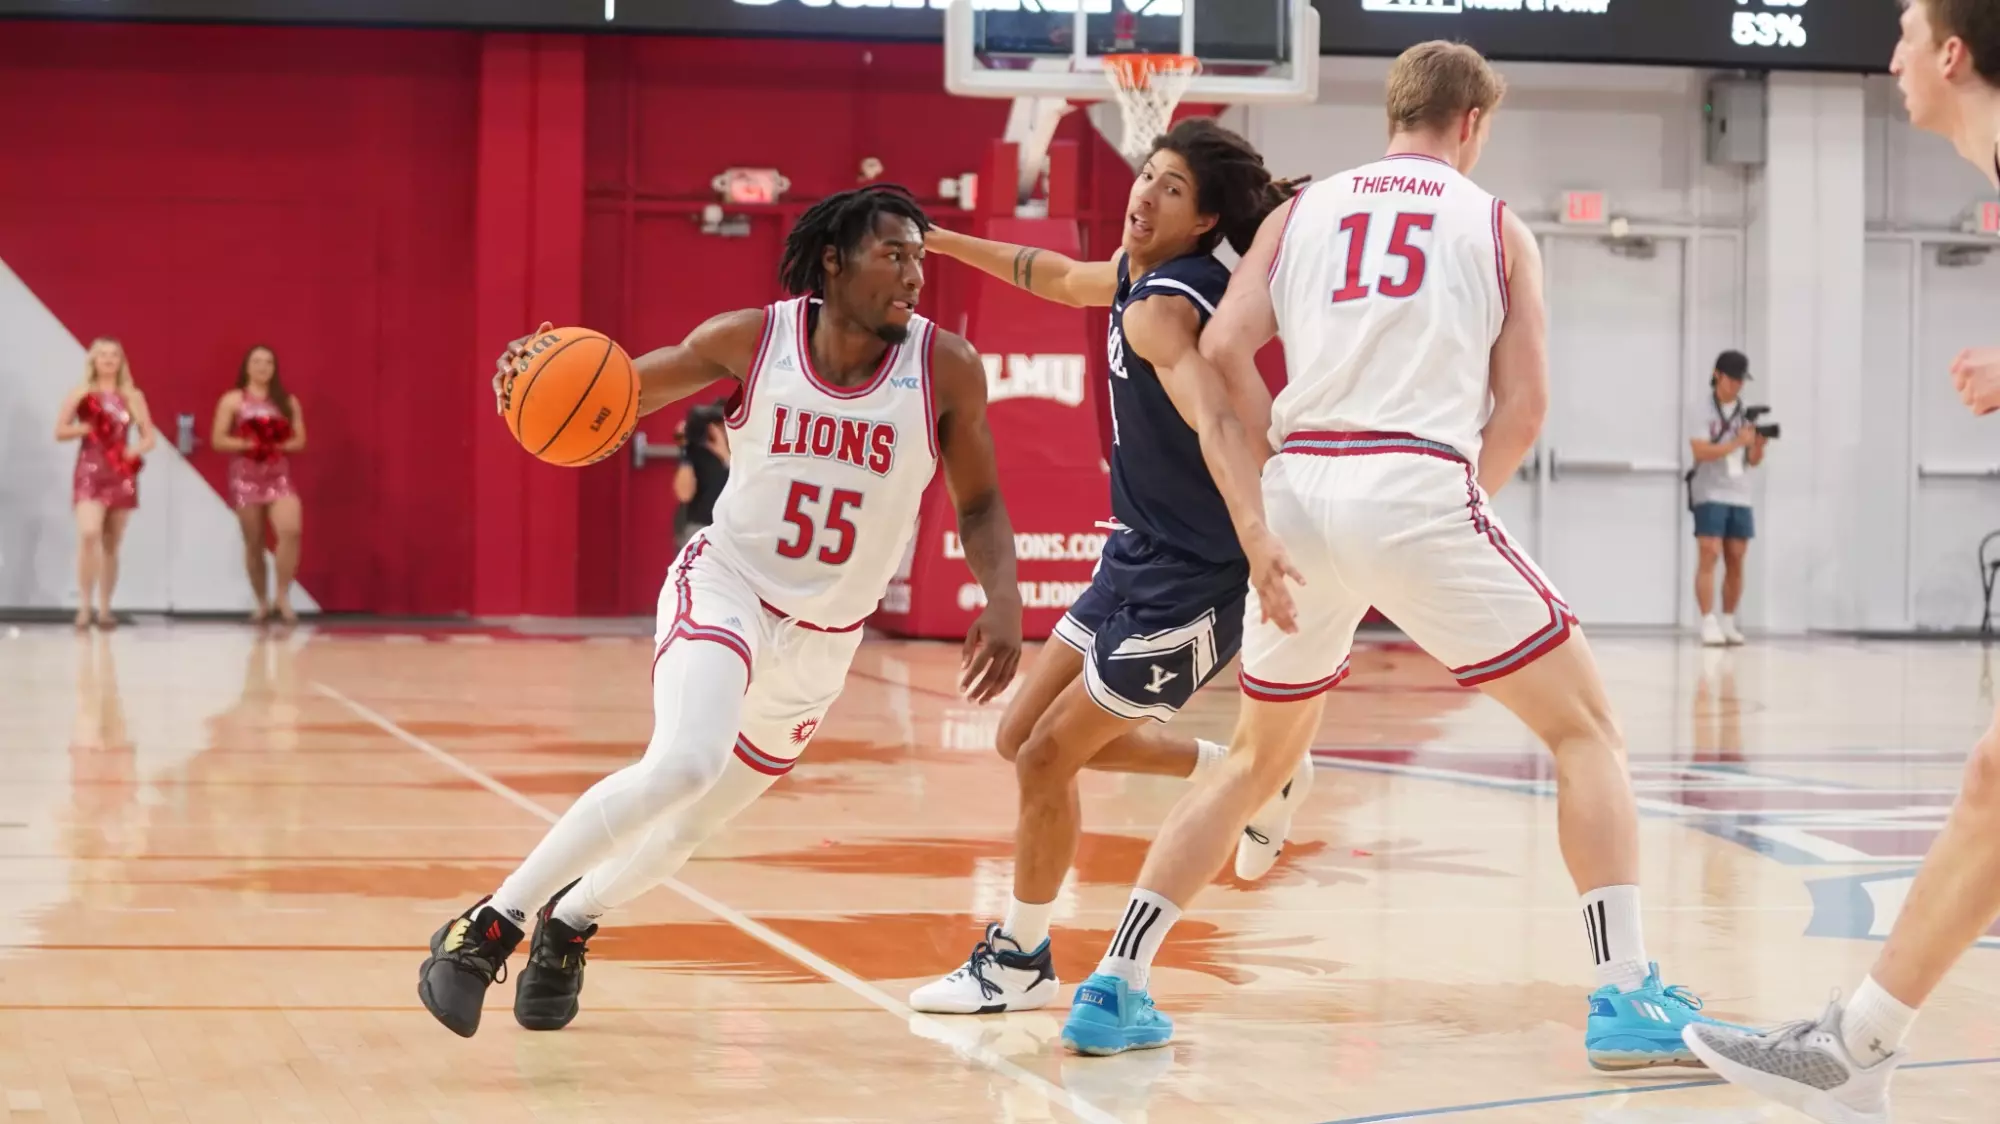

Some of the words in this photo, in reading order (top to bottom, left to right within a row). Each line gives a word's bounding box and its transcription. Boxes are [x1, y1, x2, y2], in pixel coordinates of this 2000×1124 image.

[1731, 12, 1807, 47] 53%
[1352, 176, 1446, 197] THIEMANN
[1331, 211, 1437, 304] 15
[980, 353, 1086, 408] LMU
[768, 403, 898, 479] LIONS
[775, 480, 864, 565] 55
[1143, 663, 1180, 695] Y
